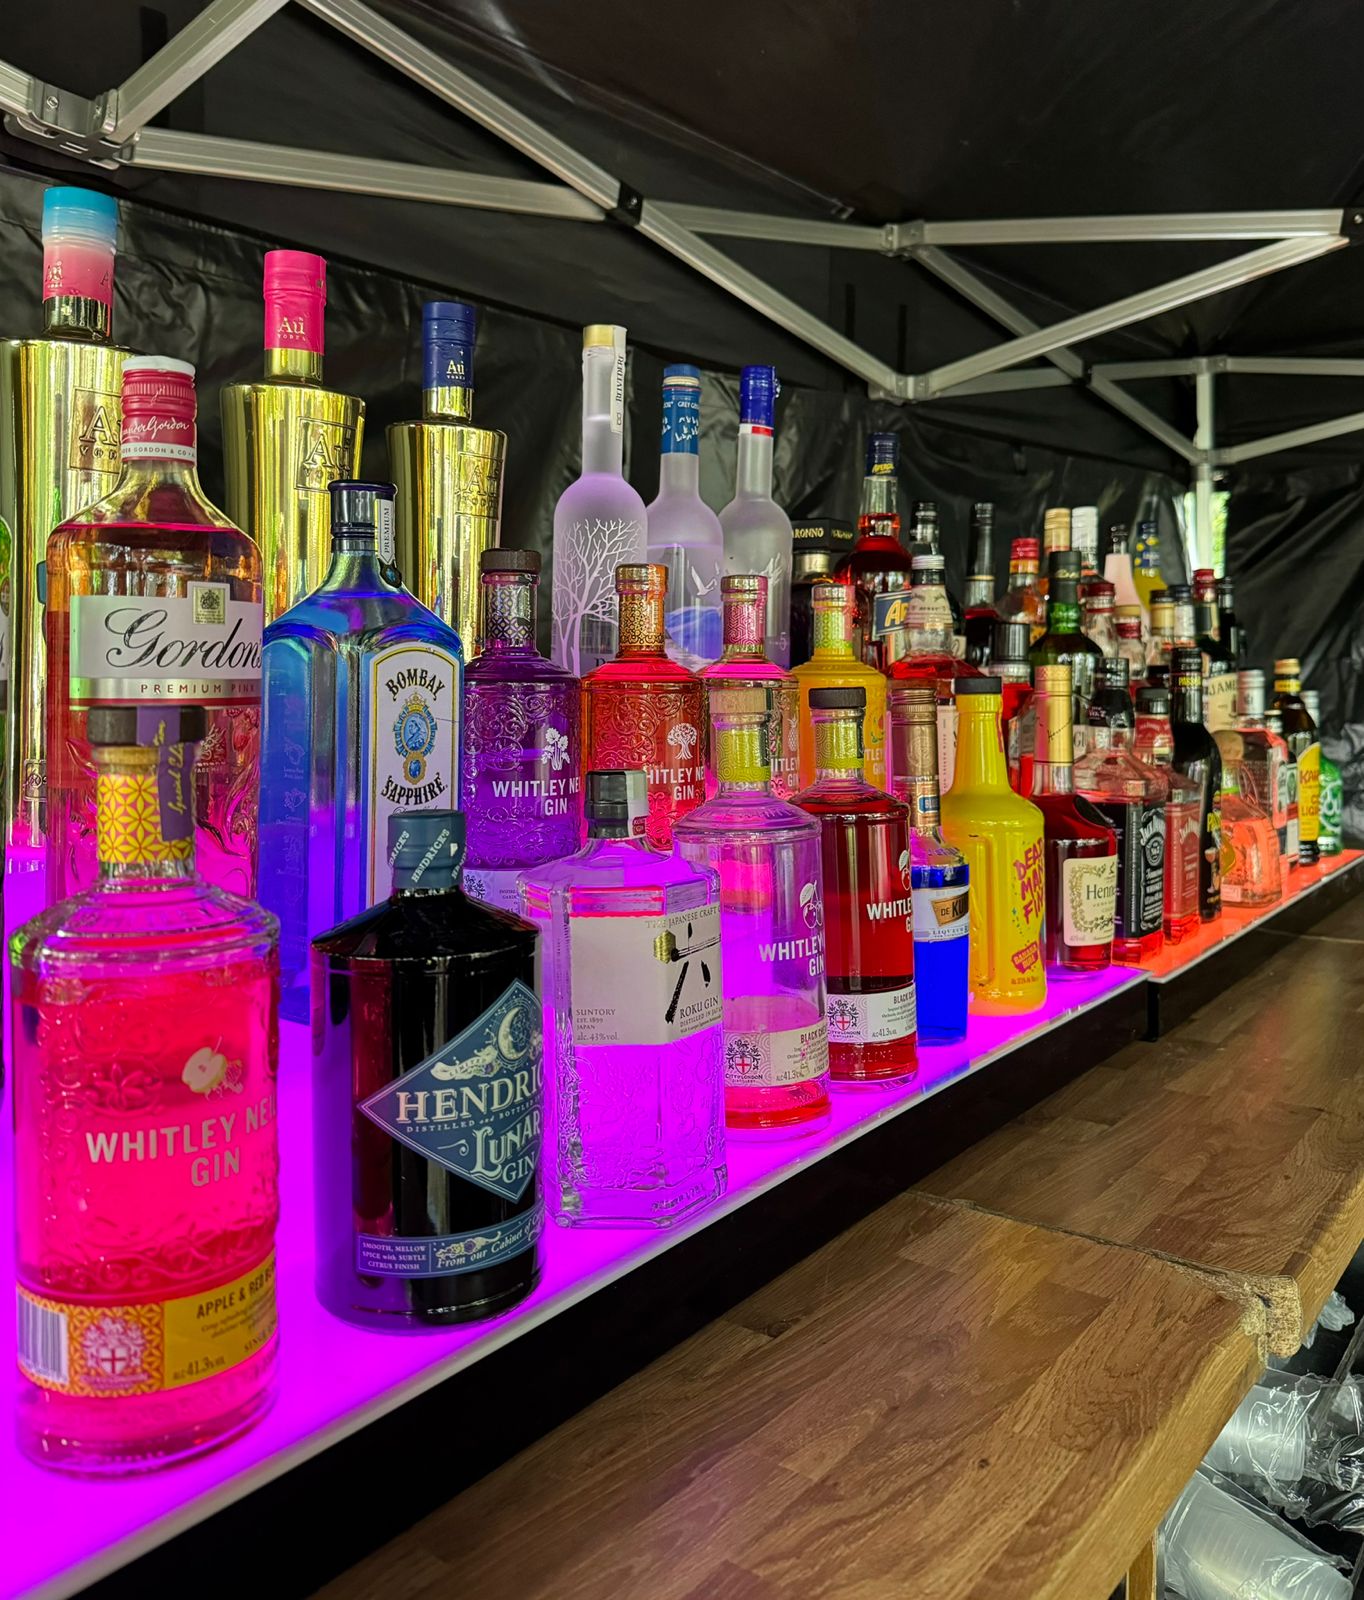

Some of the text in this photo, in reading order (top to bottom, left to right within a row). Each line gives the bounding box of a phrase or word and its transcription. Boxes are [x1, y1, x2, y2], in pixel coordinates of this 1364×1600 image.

[140, 684, 256, 694] PREMIUM PINK
[385, 668, 446, 701] BOMBAY
[381, 772, 445, 806] SAPPHIRE
[492, 779, 566, 798] WHITLEY
[673, 785, 695, 801] GIN
[544, 797, 568, 816] GIN
[411, 828, 451, 883] HENDRICK'S
[758, 934, 824, 962] WHITLEY
[576, 1008, 616, 1016] SUNTORY
[680, 995, 719, 1019] ROKU GIN
[85, 1113, 236, 1164] WHITLEY
[406, 1119, 476, 1134] DISTILLED
[191, 1147, 240, 1188] GIN
[502, 1151, 535, 1184] GIN
[362, 1251, 381, 1260] SPICE
[470, 1249, 488, 1262] our
[196, 1291, 236, 1320] APPLE
[238, 1287, 246, 1302] &
